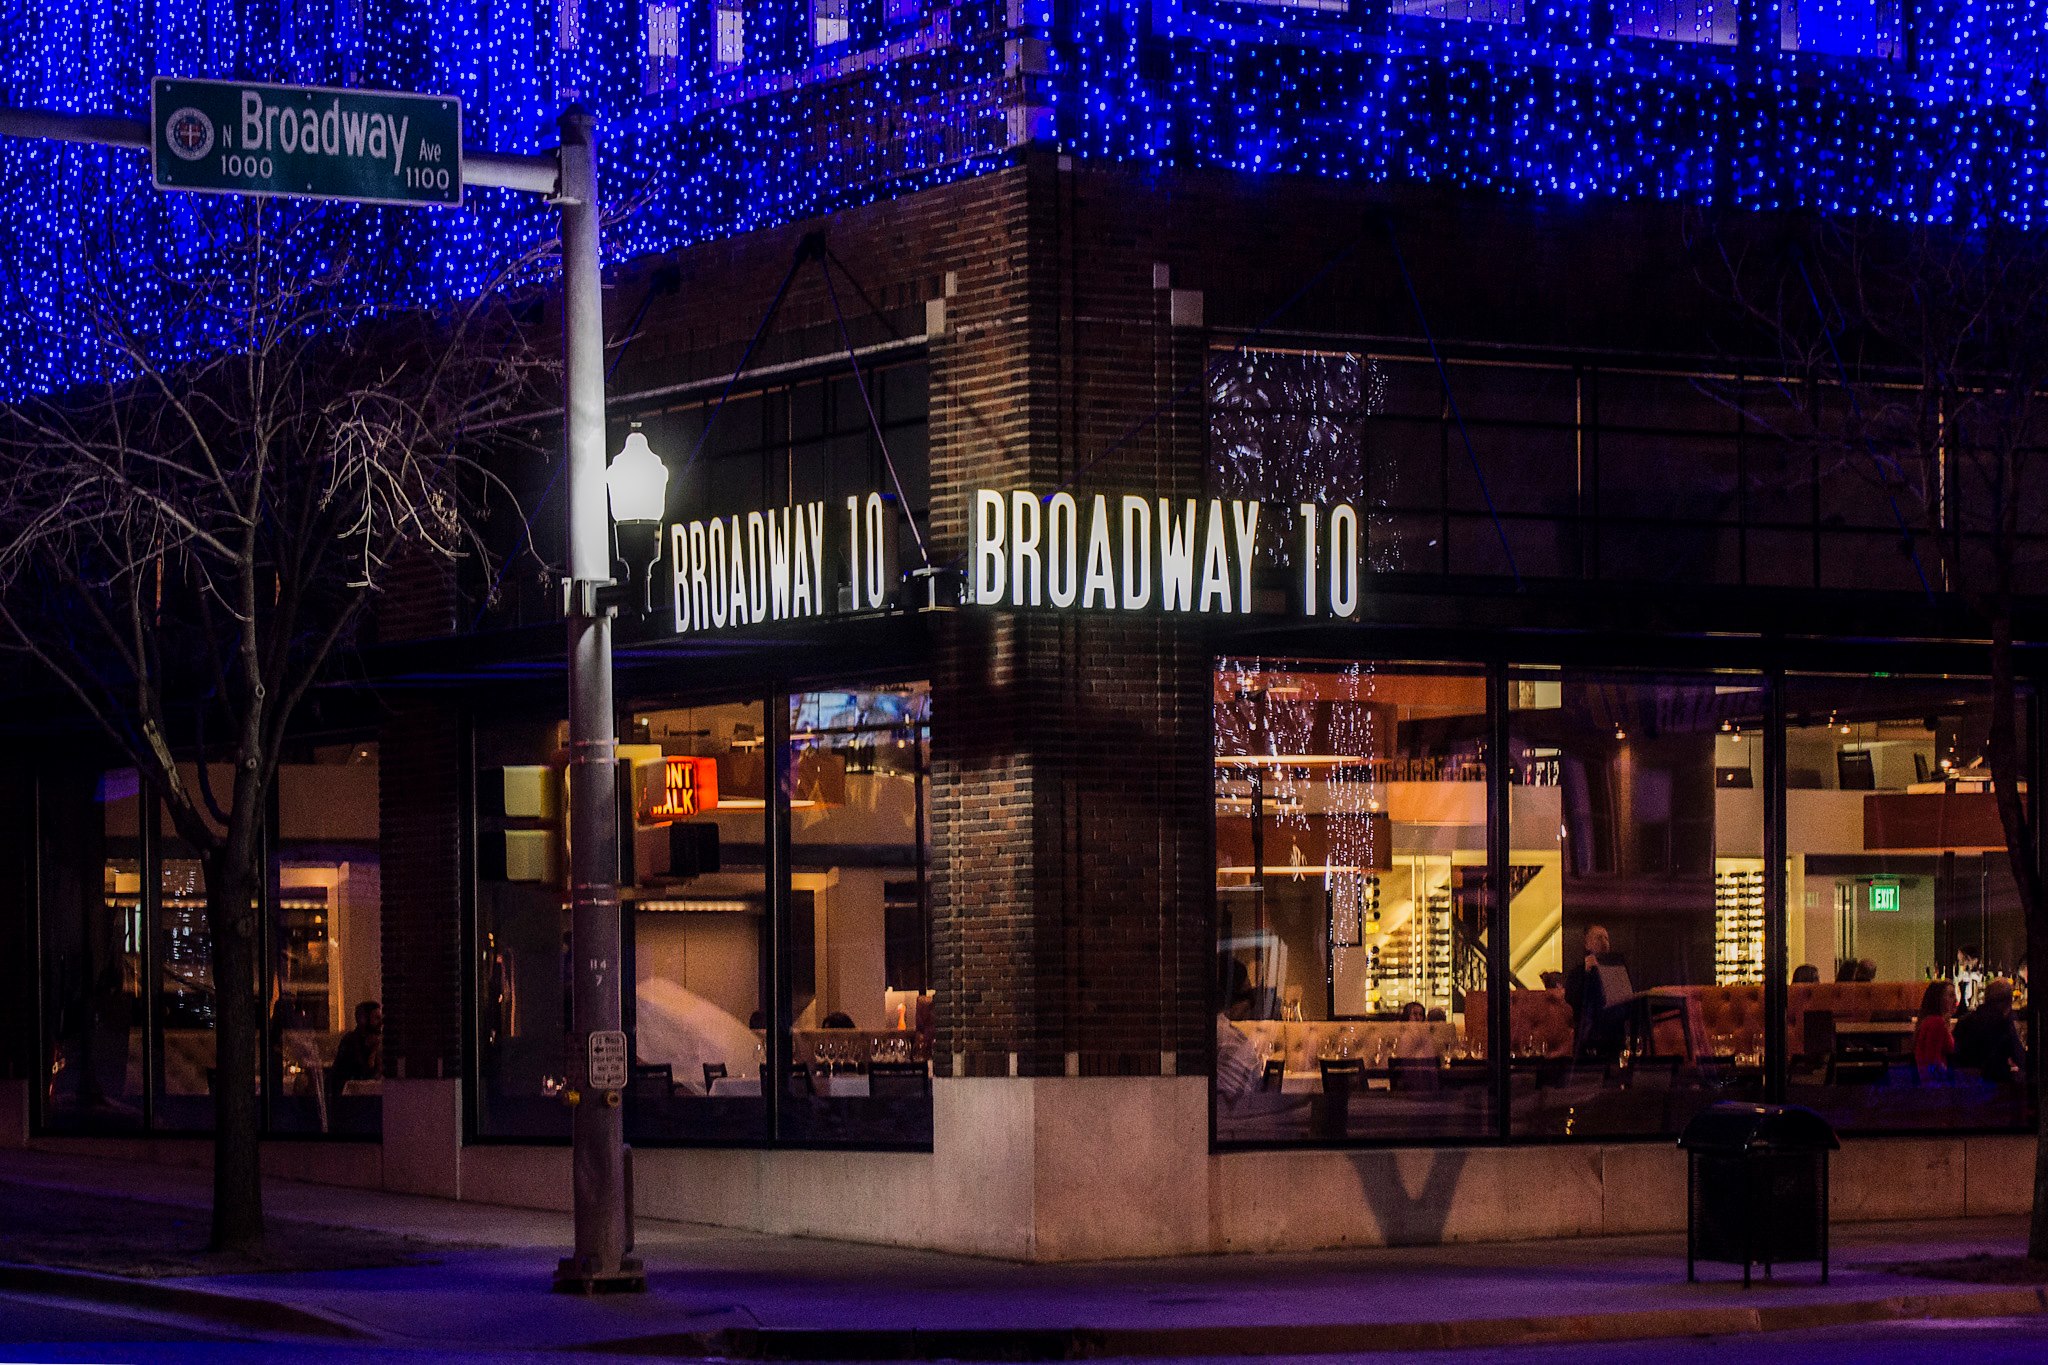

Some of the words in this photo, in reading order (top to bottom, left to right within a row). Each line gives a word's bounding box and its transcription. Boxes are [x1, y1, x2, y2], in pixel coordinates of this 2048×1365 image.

[223, 124, 232, 148] N
[241, 89, 409, 176] Broadway
[419, 138, 442, 162] Ave
[221, 154, 273, 179] 1000
[405, 166, 449, 190] 1100
[670, 500, 824, 633] BROADWAY
[847, 491, 885, 611] 10
[976, 488, 1260, 614] BROADWAY
[1300, 503, 1358, 618] 10
[1875, 888, 1895, 910] EXIT
